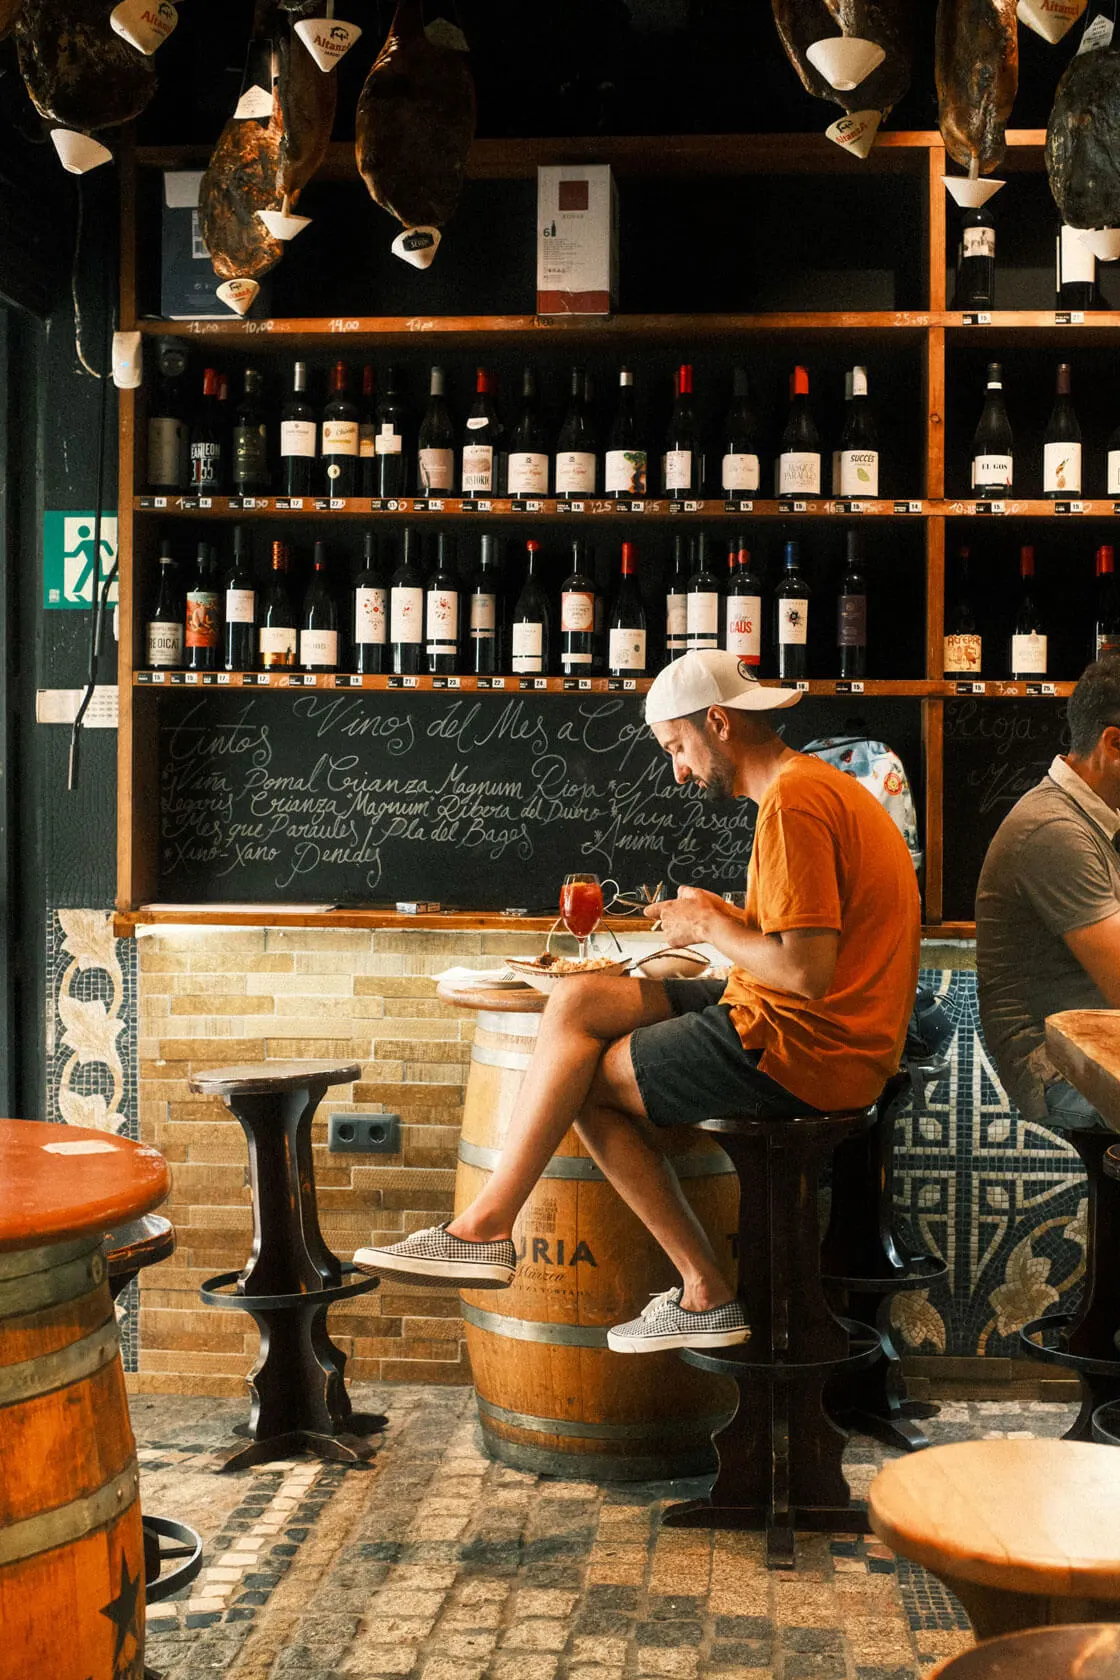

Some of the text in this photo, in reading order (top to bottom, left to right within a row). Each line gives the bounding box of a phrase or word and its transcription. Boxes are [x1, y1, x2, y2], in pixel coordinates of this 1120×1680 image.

[292, 695, 416, 756] Vinos
[427, 700, 481, 753] del
[557, 721, 579, 741] a
[236, 753, 329, 801] Pomal
[327, 755, 433, 800] Crianza
[434, 762, 524, 805] Magnum
[524, 754, 605, 808] Rioja
[251, 791, 346, 824] Crianza
[520, 796, 545, 820] del
[540, 799, 609, 826] Duero
[431, 819, 460, 842] del
